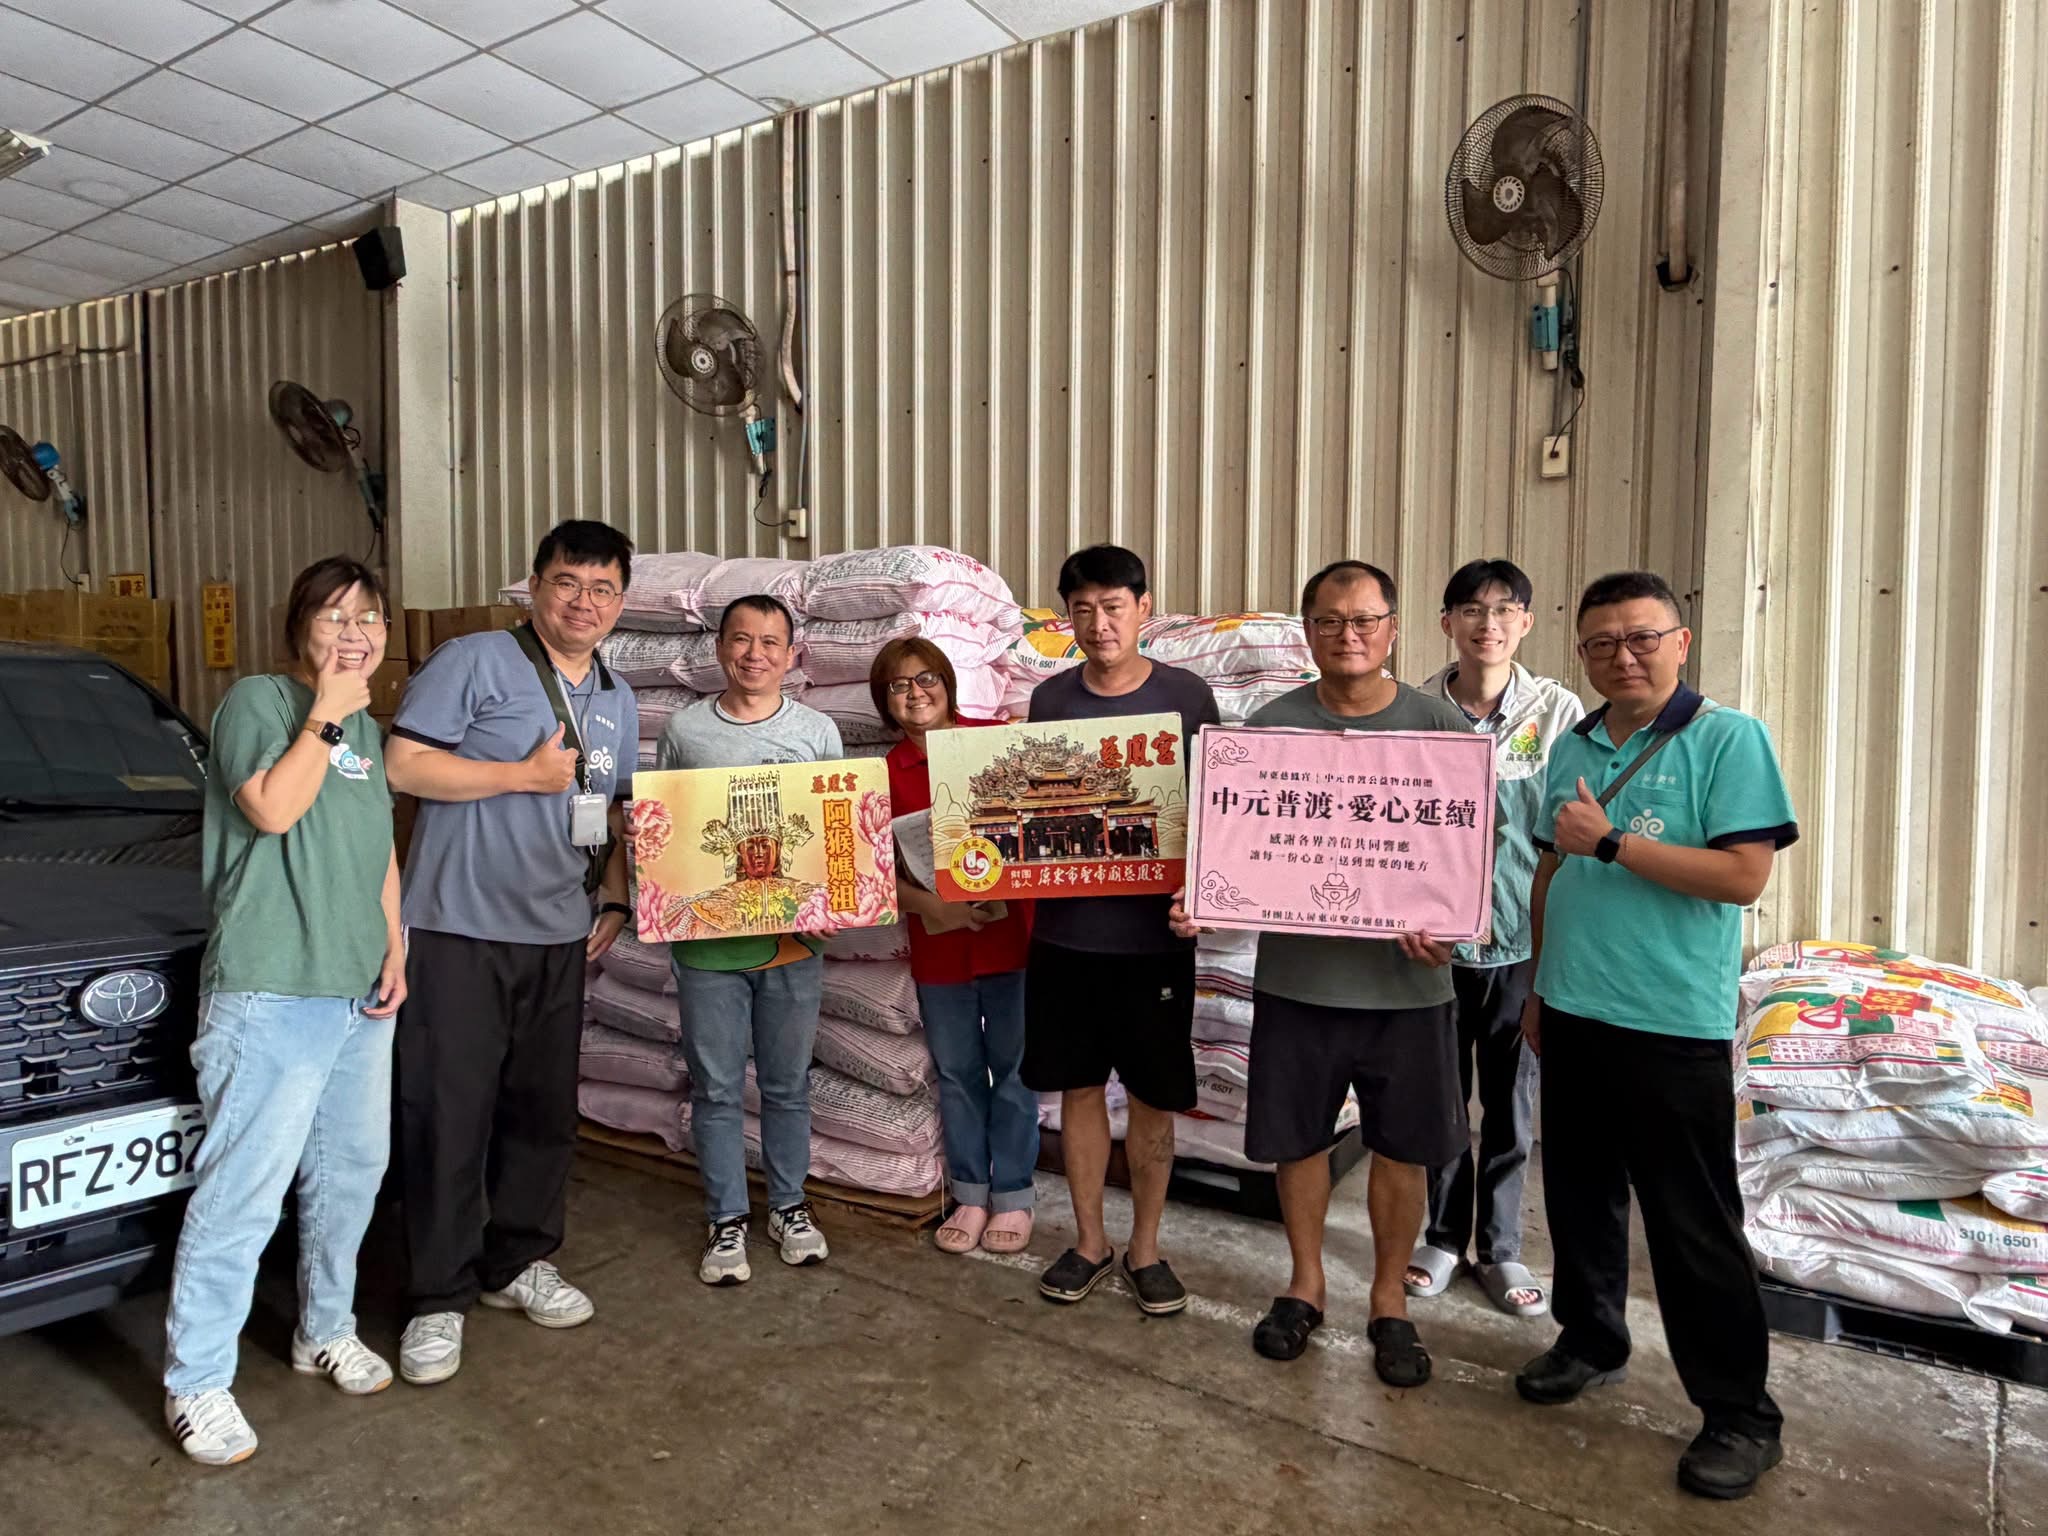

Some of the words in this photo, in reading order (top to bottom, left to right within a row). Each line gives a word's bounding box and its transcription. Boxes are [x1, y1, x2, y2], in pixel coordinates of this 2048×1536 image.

[823, 799, 859, 914] 阿猴媽祖
[1269, 832, 1410, 853] 感謝各界善信共同響應
